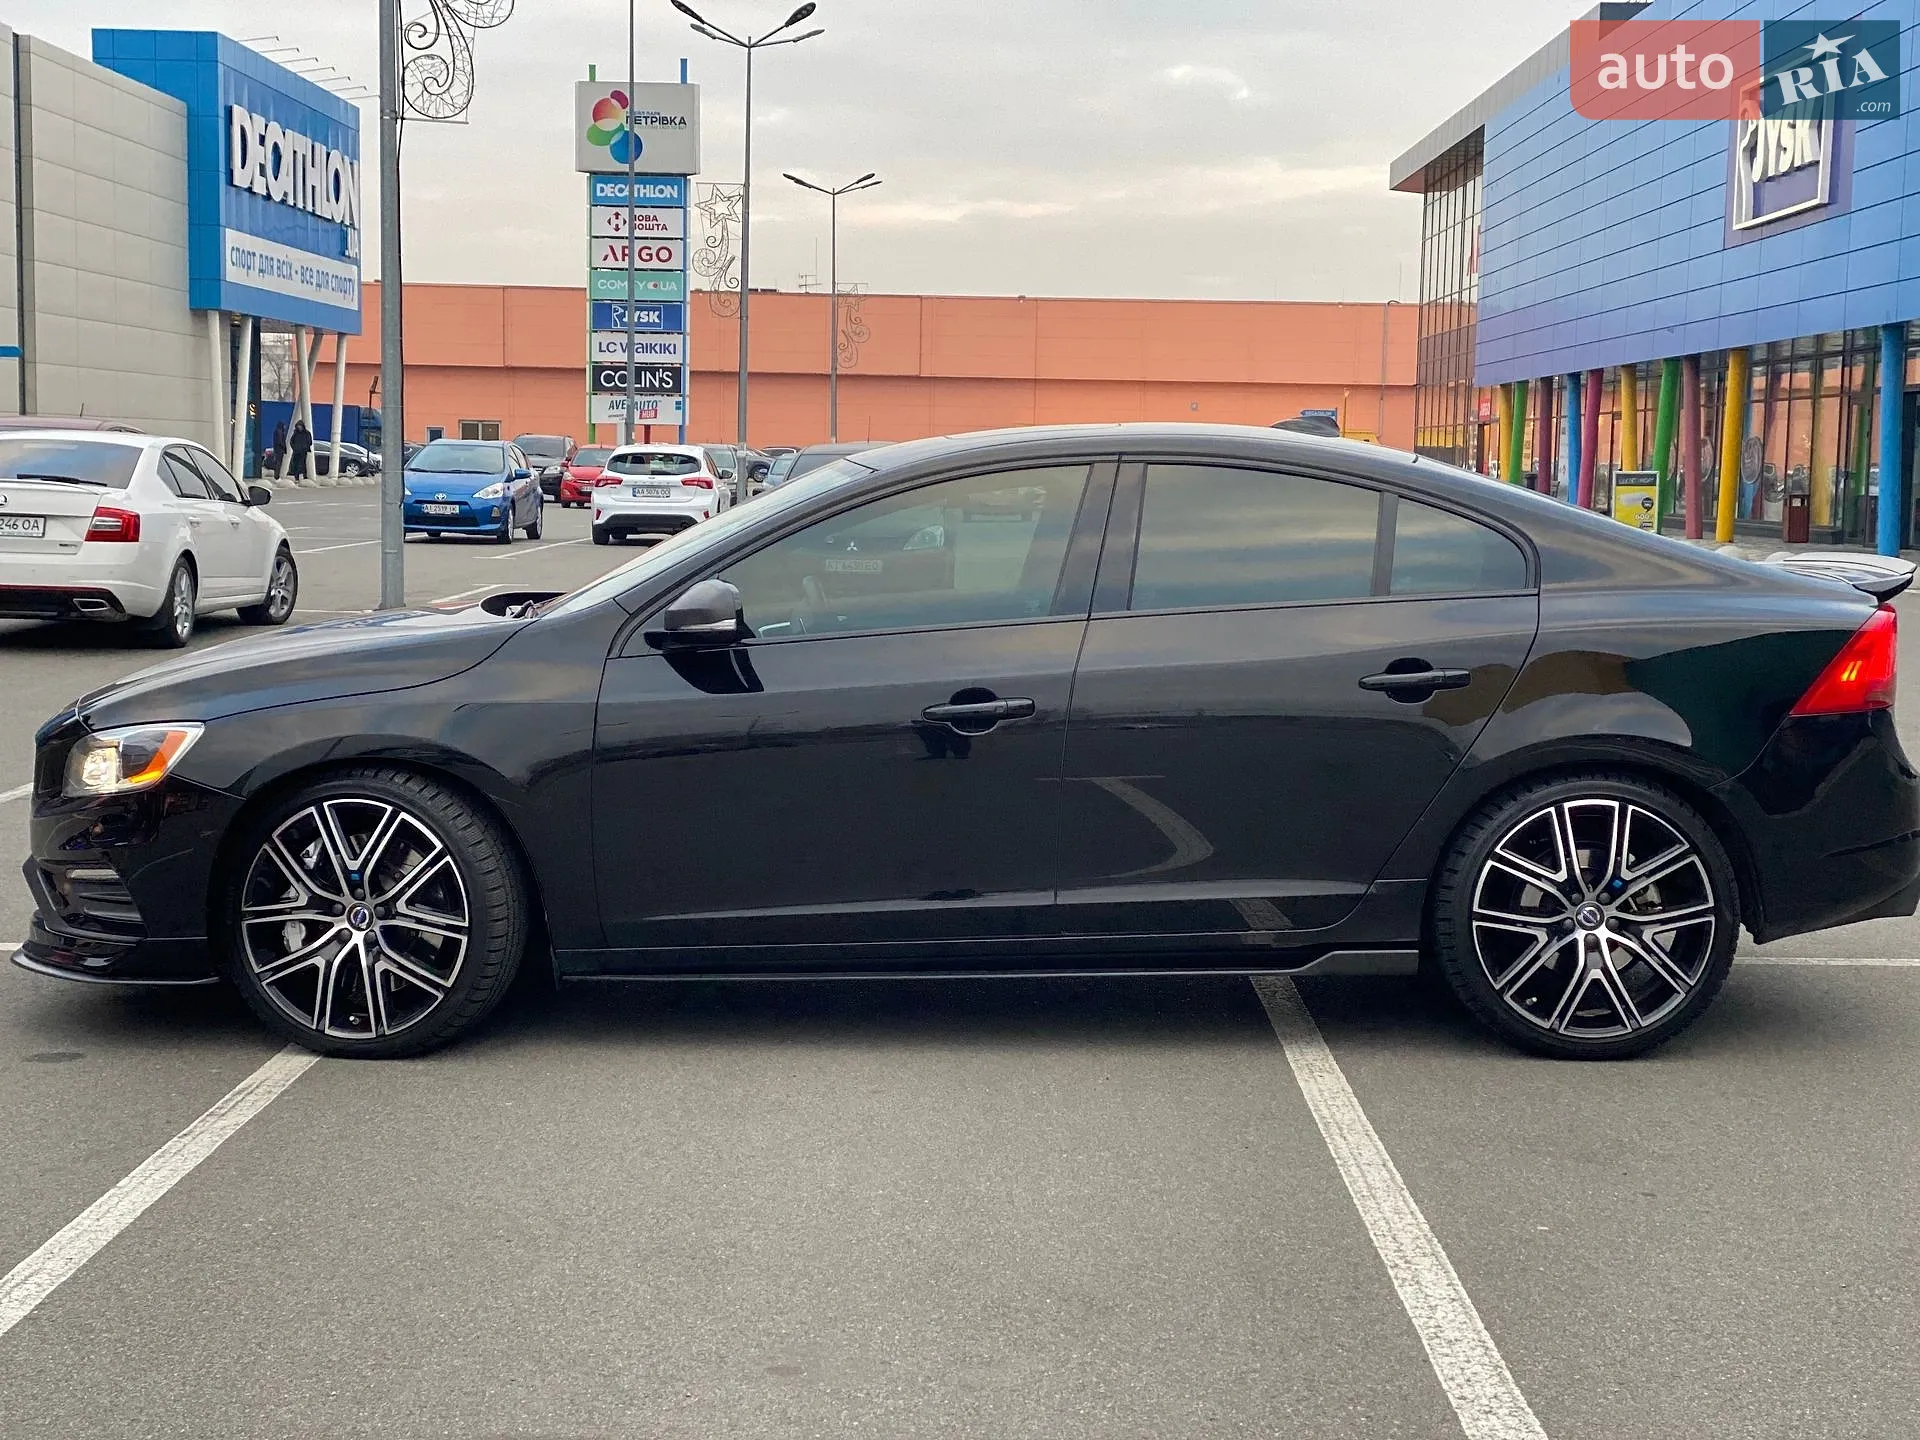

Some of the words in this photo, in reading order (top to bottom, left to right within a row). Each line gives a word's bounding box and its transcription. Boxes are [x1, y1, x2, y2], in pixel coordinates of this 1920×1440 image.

[231, 104, 359, 228] DECATHLON
[596, 183, 678, 198] DECATHLON
[634, 214, 659, 222] ОВА
[634, 223, 668, 231] ОШТА
[230, 246, 256, 277] спорт
[258, 253, 274, 278] для
[276, 254, 293, 280] всіх
[300, 265, 314, 286] все
[315, 269, 330, 292] для
[331, 274, 355, 302] спорту
[597, 279, 645, 290] COMY
[623, 310, 660, 323] JYSK
[598, 342, 617, 353] LC
[0, 518, 19, 530] 246
[22, 519, 40, 531] OA
